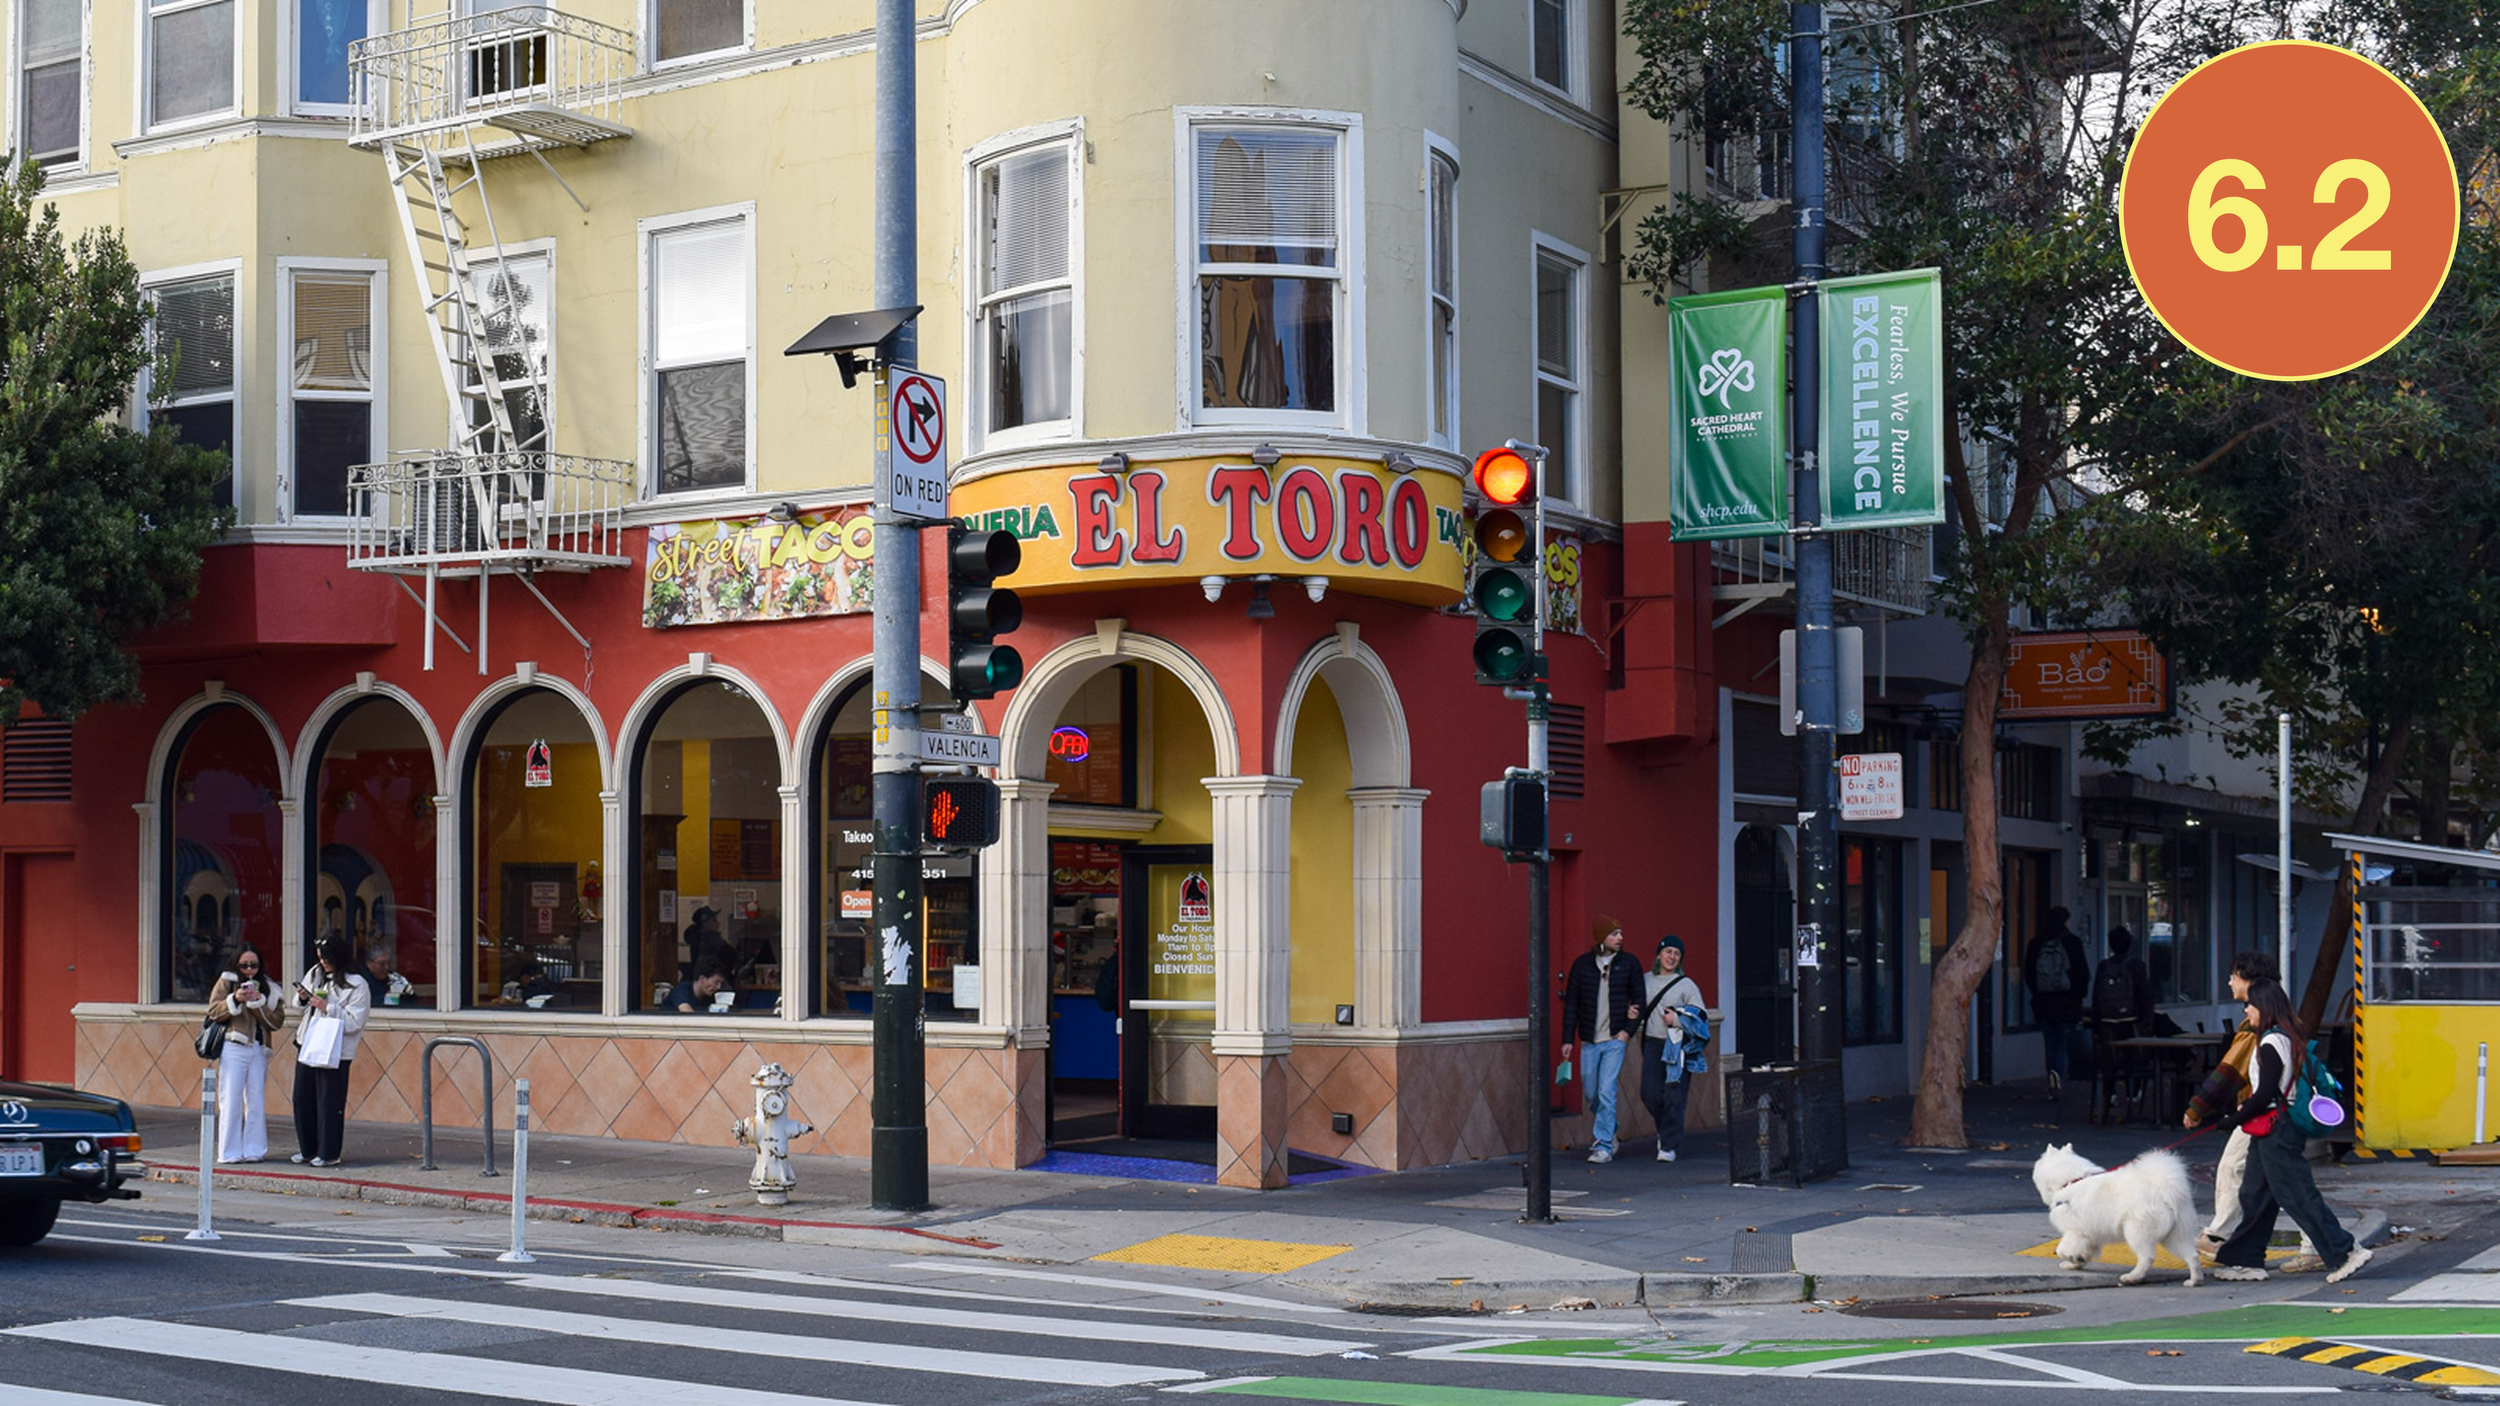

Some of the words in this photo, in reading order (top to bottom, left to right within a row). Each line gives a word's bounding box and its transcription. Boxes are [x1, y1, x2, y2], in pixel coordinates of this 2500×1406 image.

[1888, 304, 1910, 385] Fearless,
[1852, 295, 1882, 511] EXCELLENCE
[1889, 391, 1909, 423] We
[1690, 414, 1728, 427] SACRED
[1729, 411, 1764, 423] HEART
[1697, 422, 1756, 436] CATHEDRAL
[1890, 428, 1910, 495] Pursue
[895, 473, 913, 497] ON
[917, 478, 943, 504] RED
[1068, 469, 1184, 568] EL
[1210, 465, 1430, 566] TORO
[1699, 499, 1758, 520] shcp.edu
[651, 527, 754, 583] street
[955, 718, 971, 730] 600
[927, 737, 990, 759] VALENCIA
[1049, 732, 1089, 755] OPEN
[1843, 758, 1859, 774] NO
[1862, 760, 1899, 773] PARKING
[843, 895, 871, 908] Open
[1157, 934, 1187, 944] Monday
[1188, 934, 1197, 942] to
[1172, 924, 1188, 933] Our
[1162, 952, 1192, 961] Closed
[1154, 964, 1216, 974] BIENVENID
